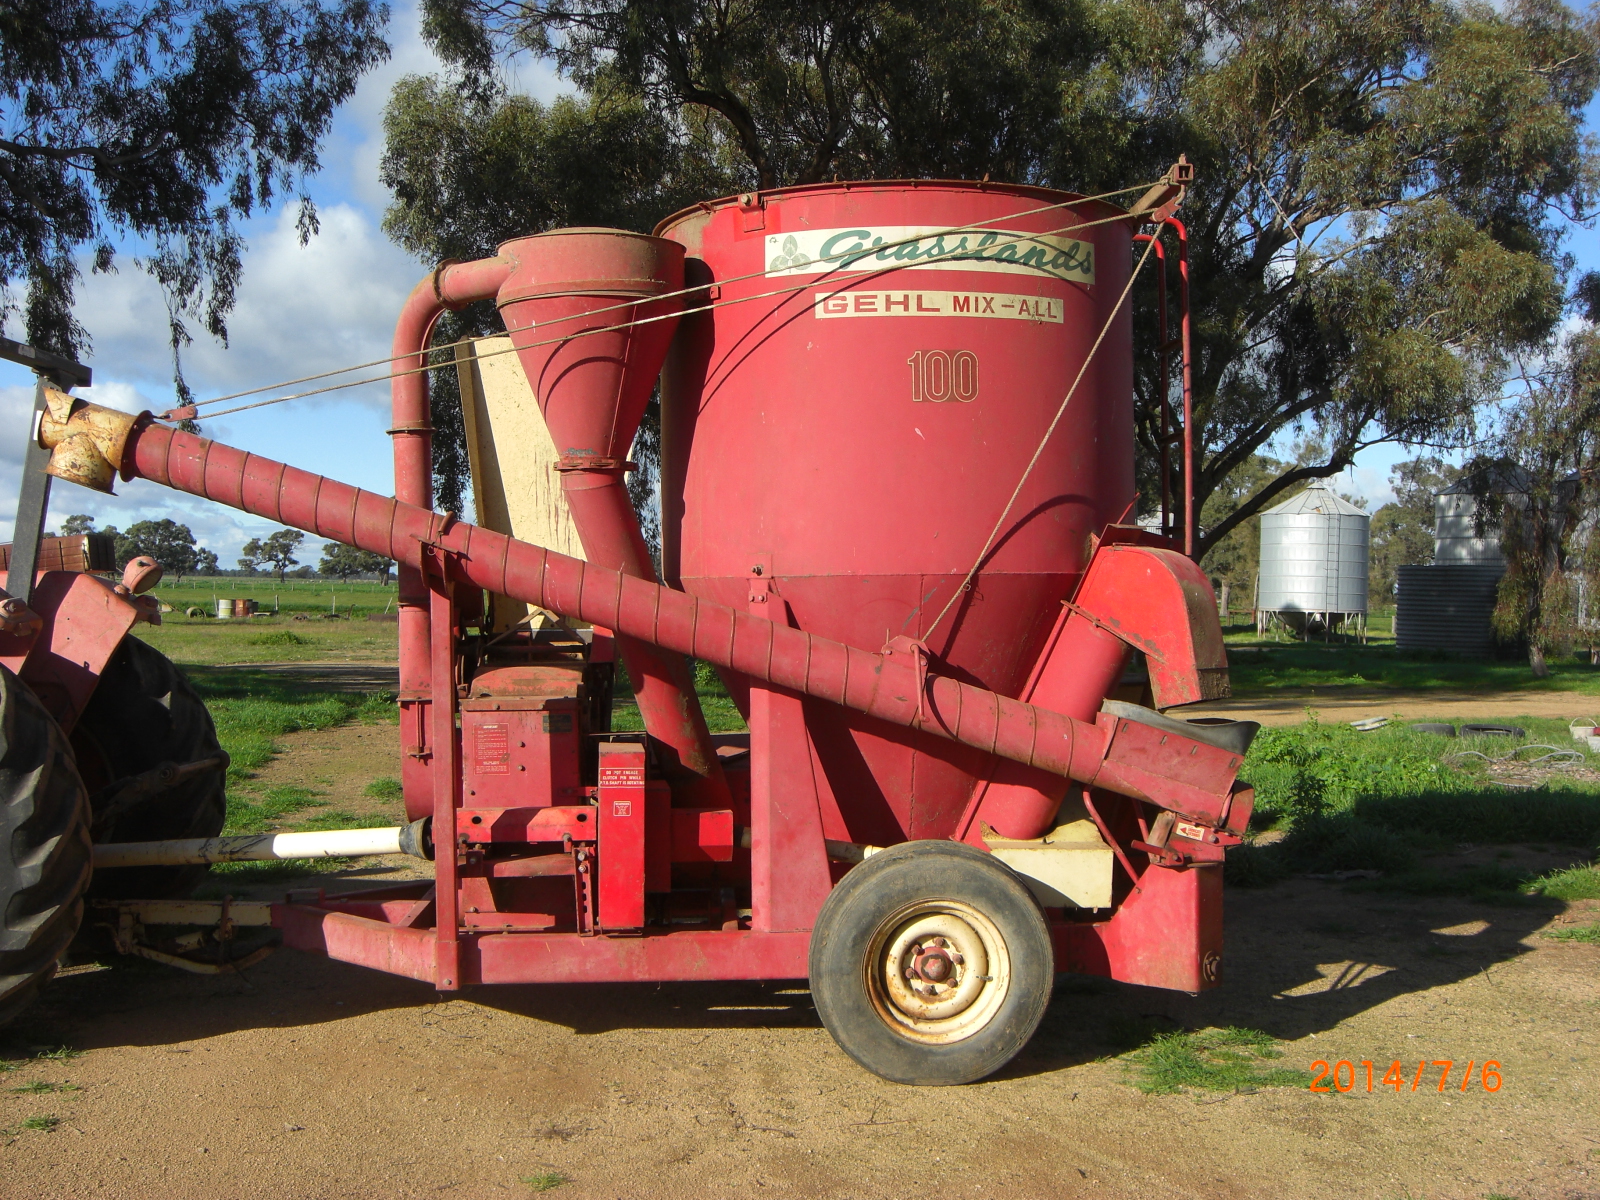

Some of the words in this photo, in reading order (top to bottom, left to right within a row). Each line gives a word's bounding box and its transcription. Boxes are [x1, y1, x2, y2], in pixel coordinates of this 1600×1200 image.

[819, 229, 1093, 275] Grasslands
[823, 294, 940, 314] GEHL
[907, 350, 979, 402] 100
